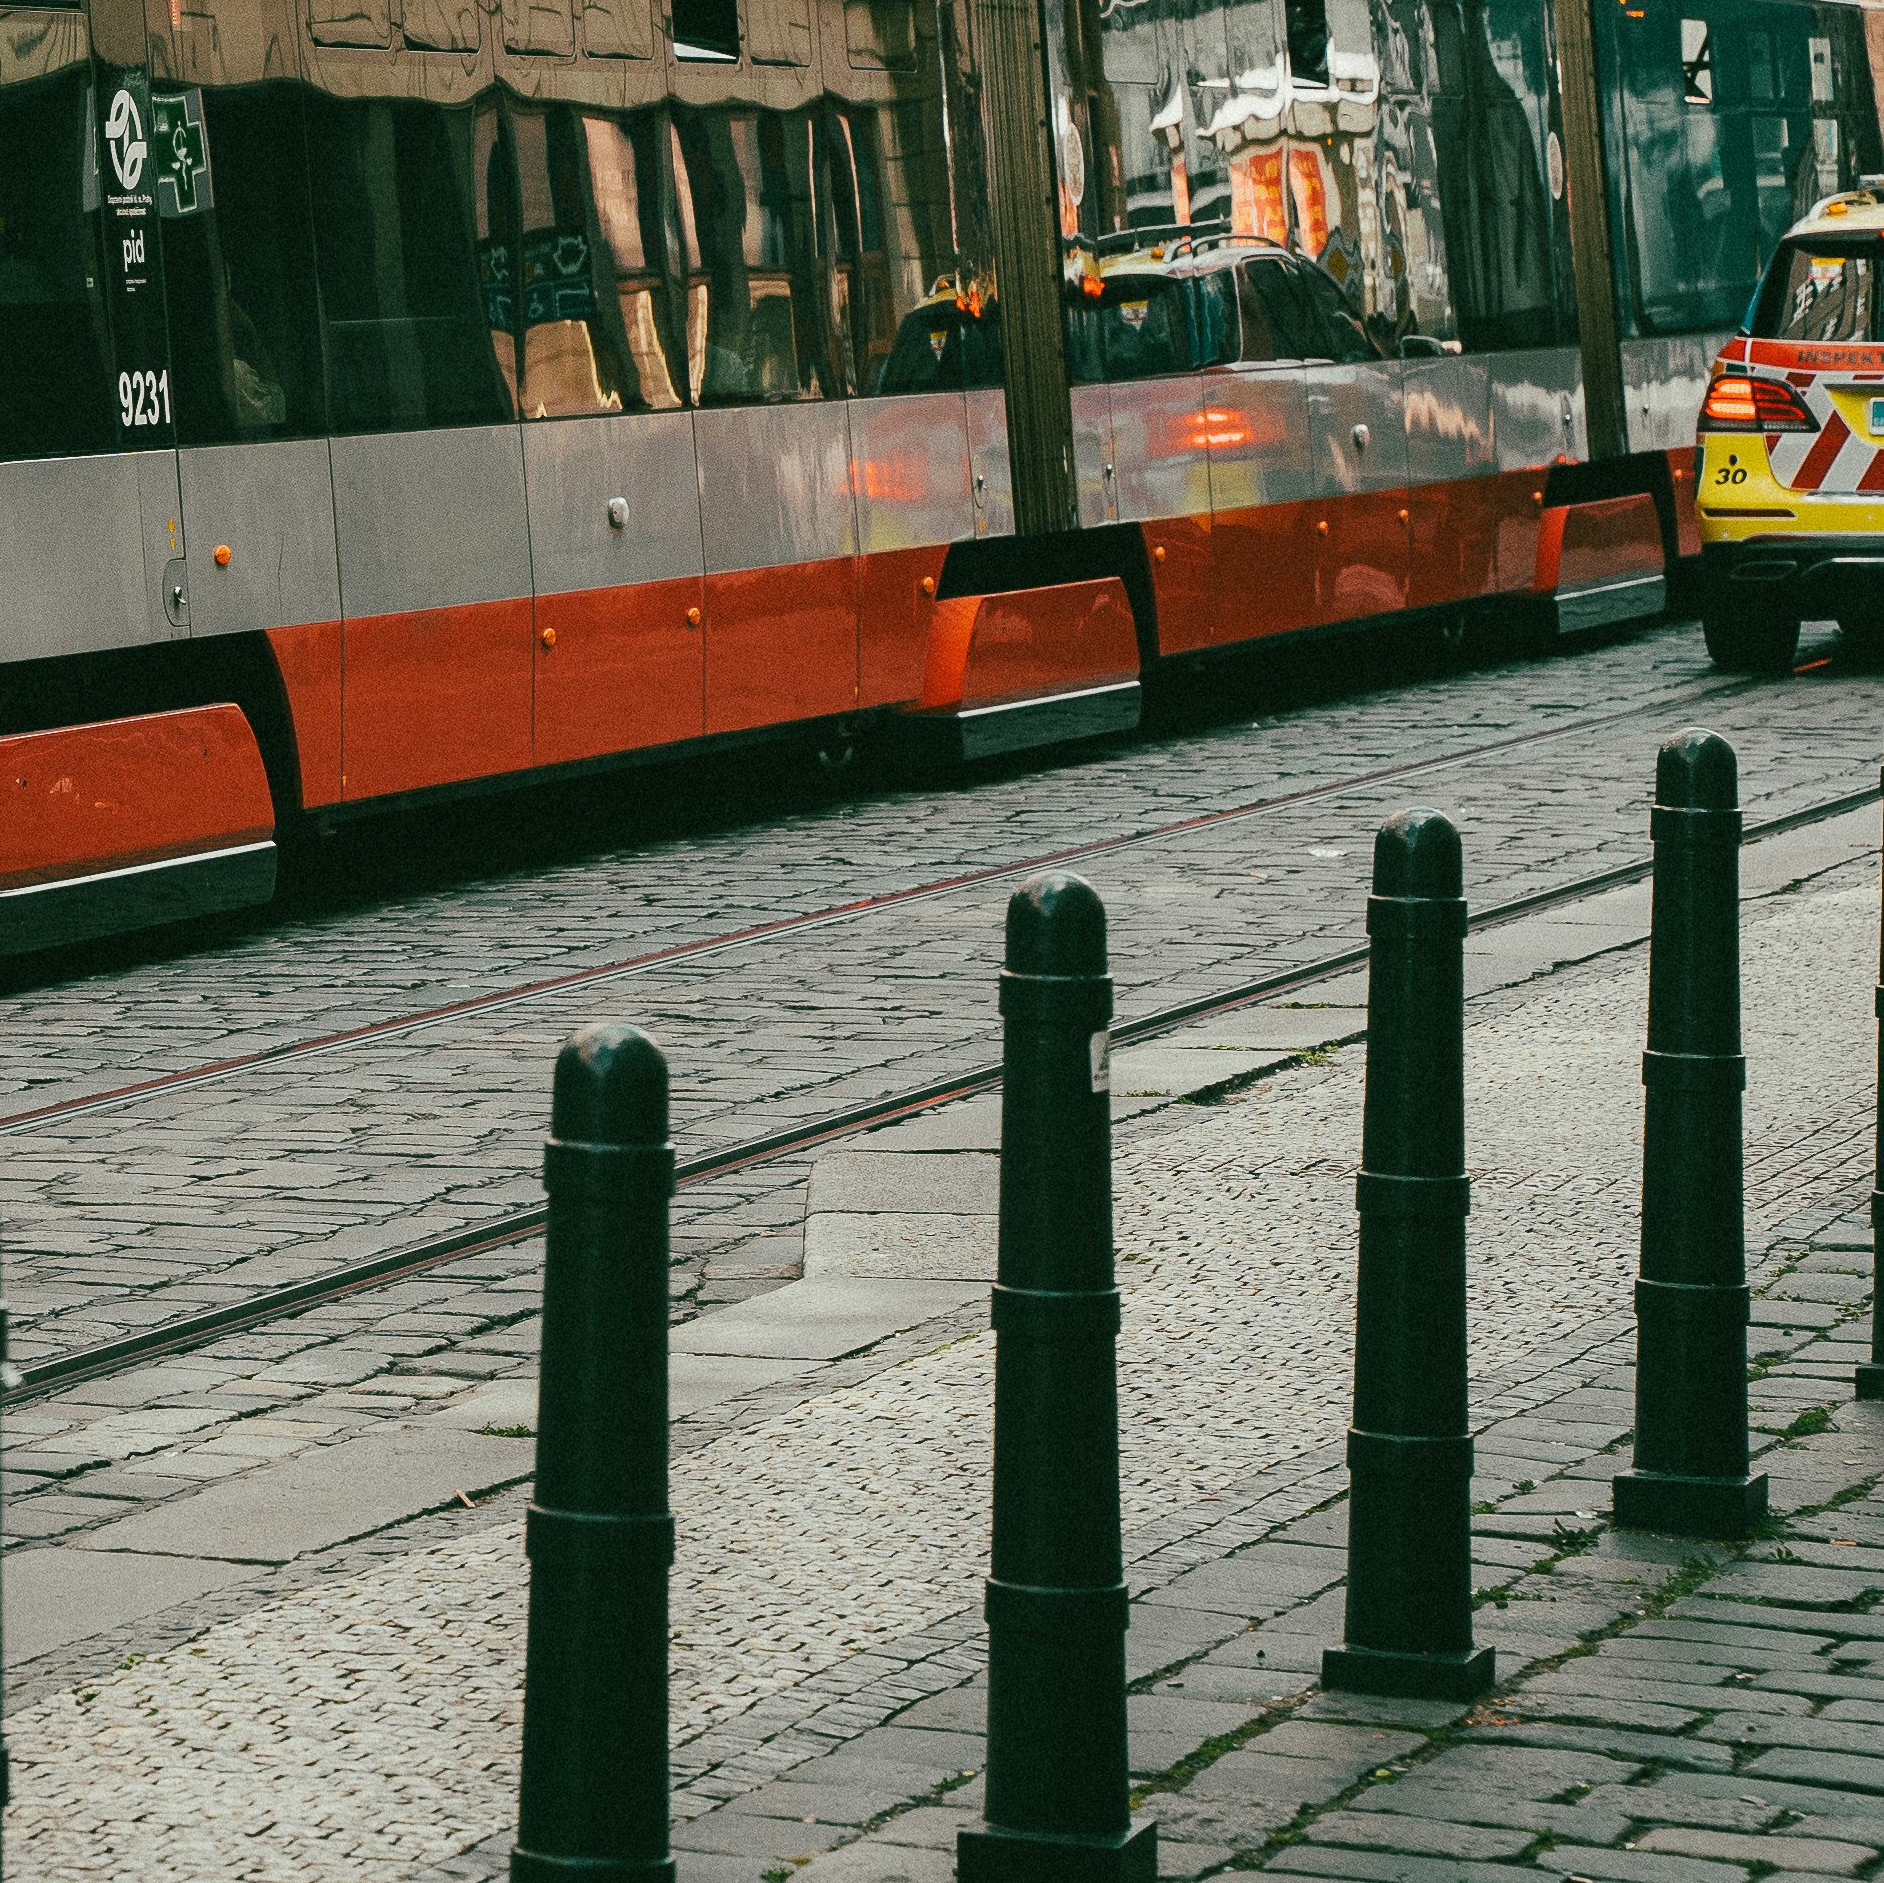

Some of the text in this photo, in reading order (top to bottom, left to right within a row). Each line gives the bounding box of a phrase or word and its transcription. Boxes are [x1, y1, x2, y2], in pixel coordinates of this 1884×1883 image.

[122, 228, 145, 273] pid
[118, 368, 172, 428] 9231
[1714, 468, 1748, 486] 30
